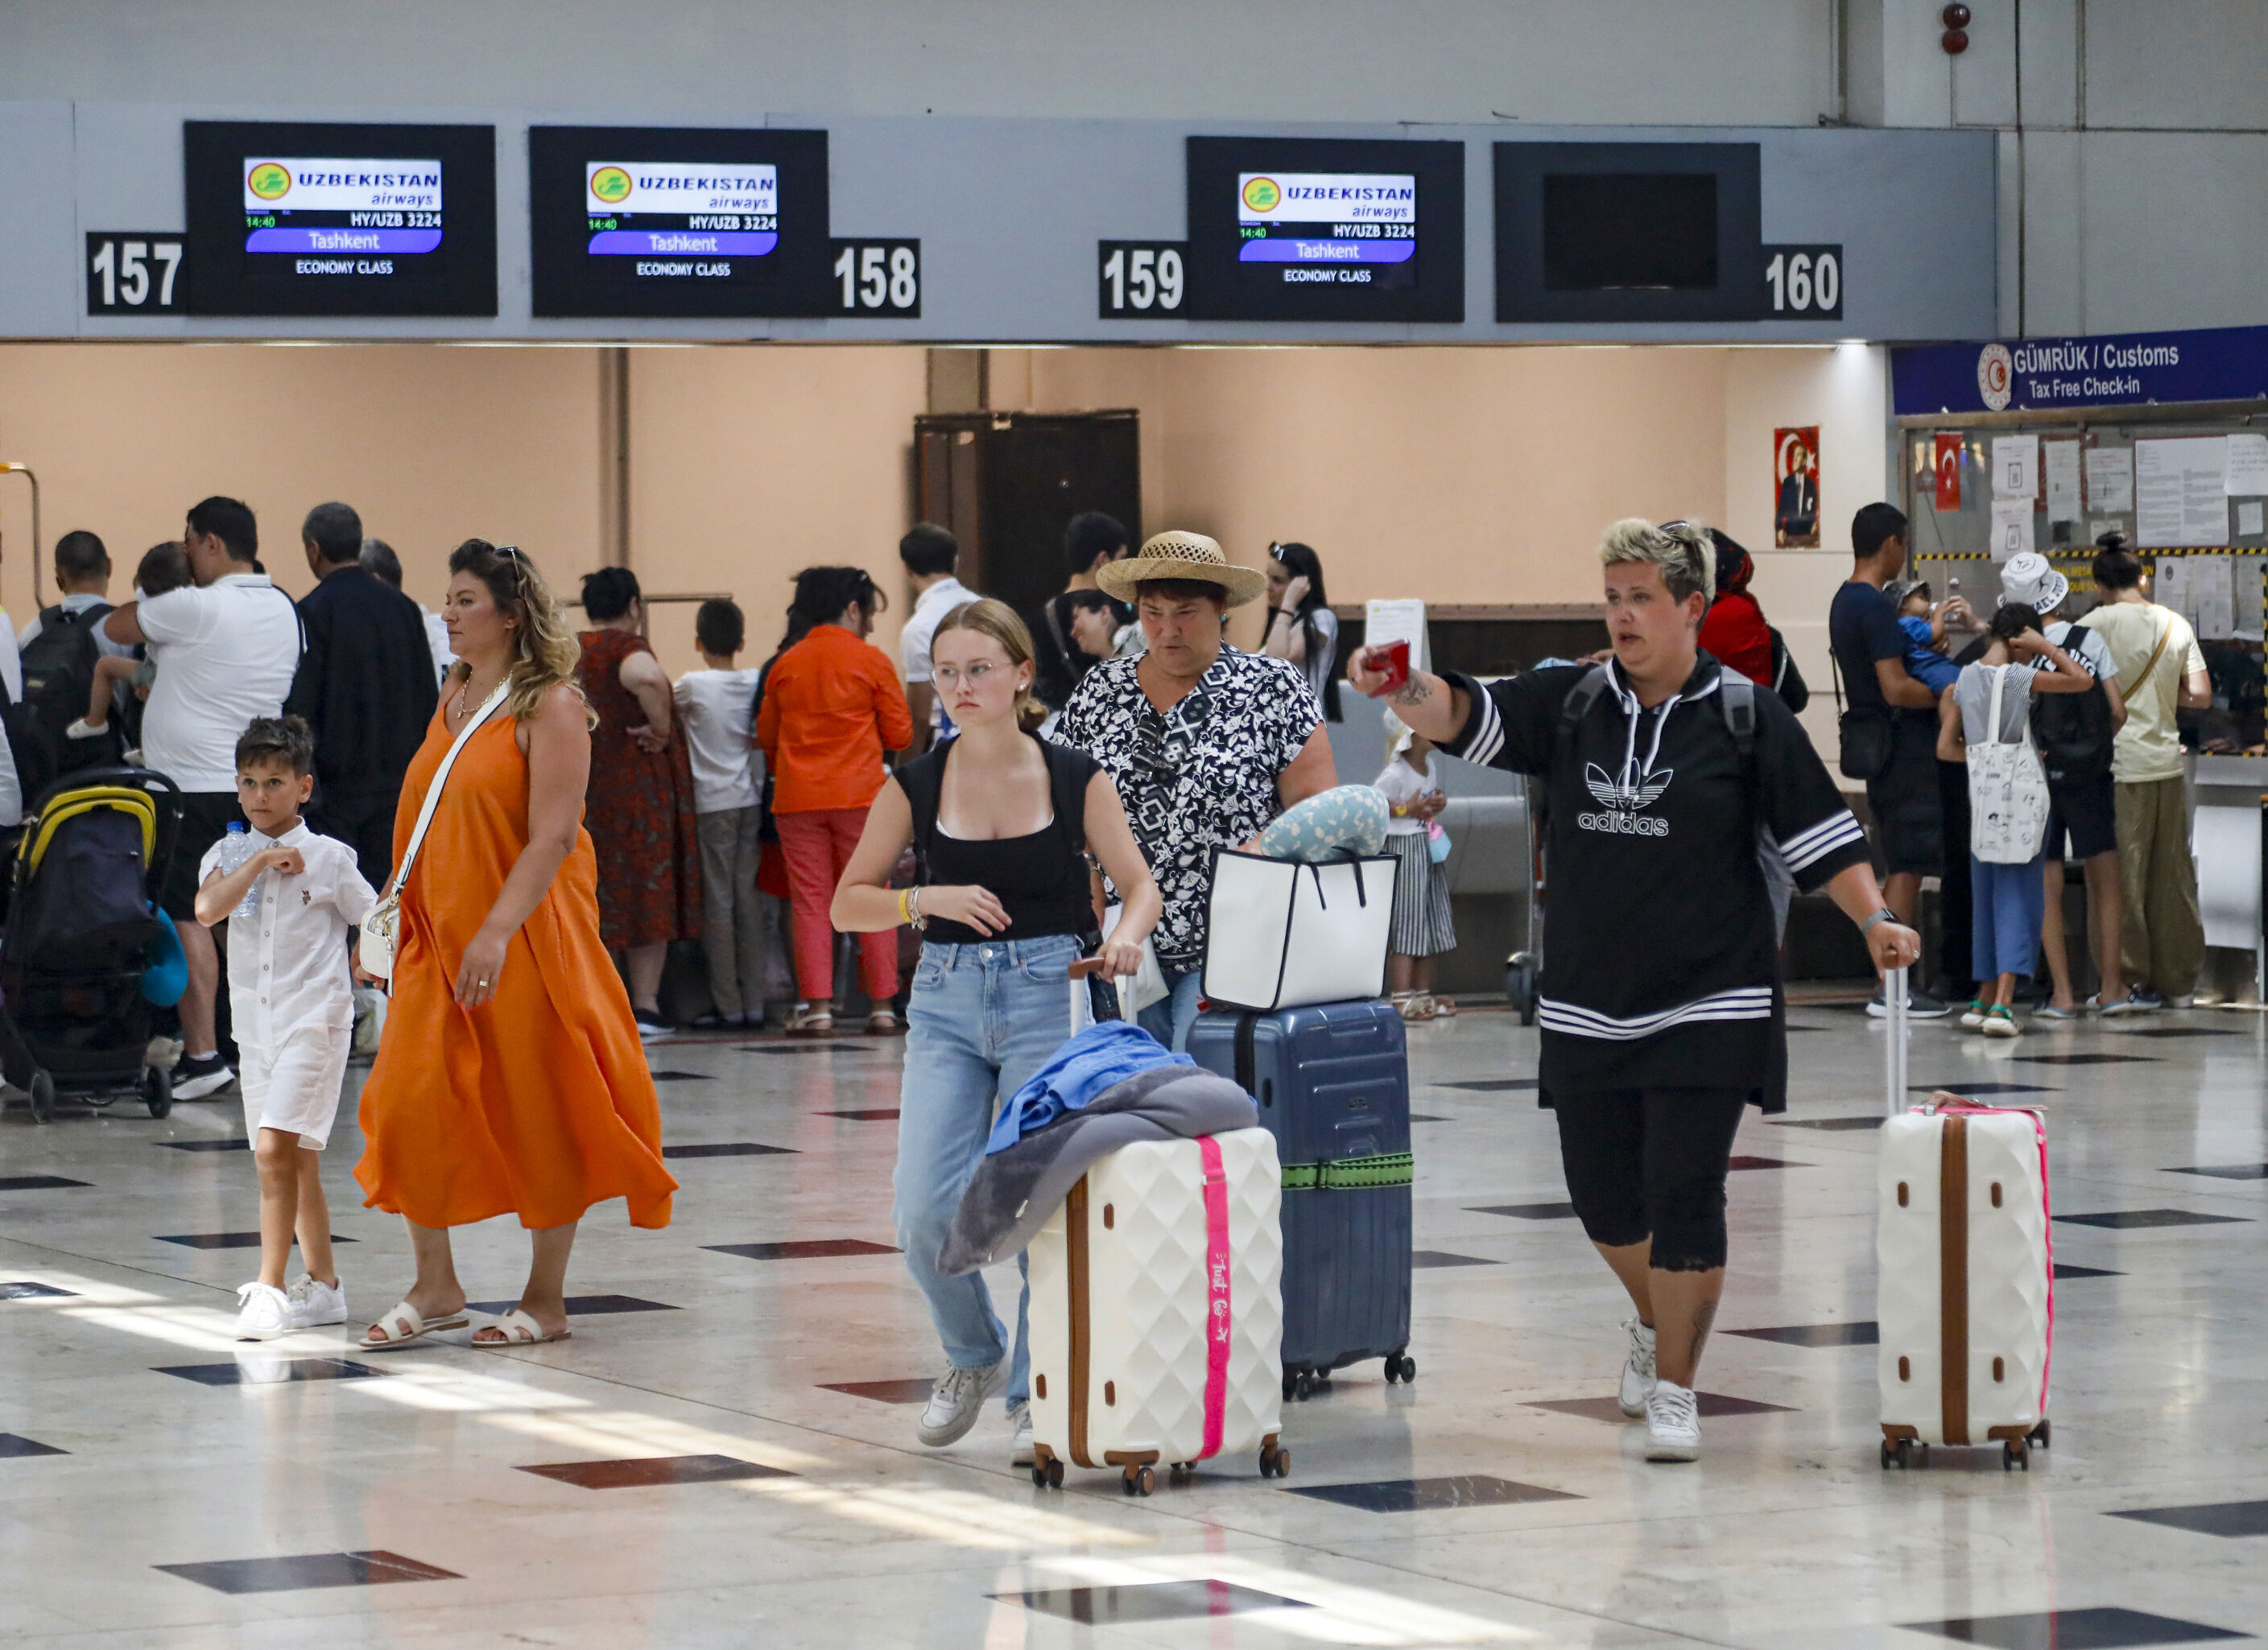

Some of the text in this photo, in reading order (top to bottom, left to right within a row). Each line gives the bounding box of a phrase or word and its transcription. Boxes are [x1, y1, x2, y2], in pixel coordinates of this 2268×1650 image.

[299, 173, 438, 188] UZBEKISTAN
[639, 177, 775, 191] UZBEKISTAN
[371, 192, 433, 208] airways
[1288, 188, 1413, 200] UZBEKISTAN
[709, 196, 769, 211] airways
[350, 212, 442, 228] HY/UZB 3224
[1352, 204, 1408, 221] airways
[246, 214, 275, 229] 14:40
[588, 217, 618, 231] 14:40
[688, 215, 778, 231] HY/UZB 3224
[1240, 227, 1267, 239] 14:40
[1333, 224, 1415, 238] HY/UZB 3224
[308, 231, 380, 250] Tashkent
[648, 233, 718, 252] Tashkent
[1295, 242, 1360, 258] Tashkent
[92, 241, 184, 307] 157
[295, 259, 394, 274] ECONOMY CLASS
[636, 262, 732, 277] ECONOMY CLASS
[834, 245, 917, 310] 158
[1104, 249, 1184, 311] 159
[1283, 269, 1372, 283] ECONOMY CLASS
[1765, 252, 1840, 311] 160
[2014, 340, 2089, 374] GÜMRÜK
[2103, 343, 2179, 369] Customs
[2029, 375, 2140, 399] Tax Free Check-in
[1578, 811, 1669, 836] adidas
[1212, 1258, 1229, 1294] Just
